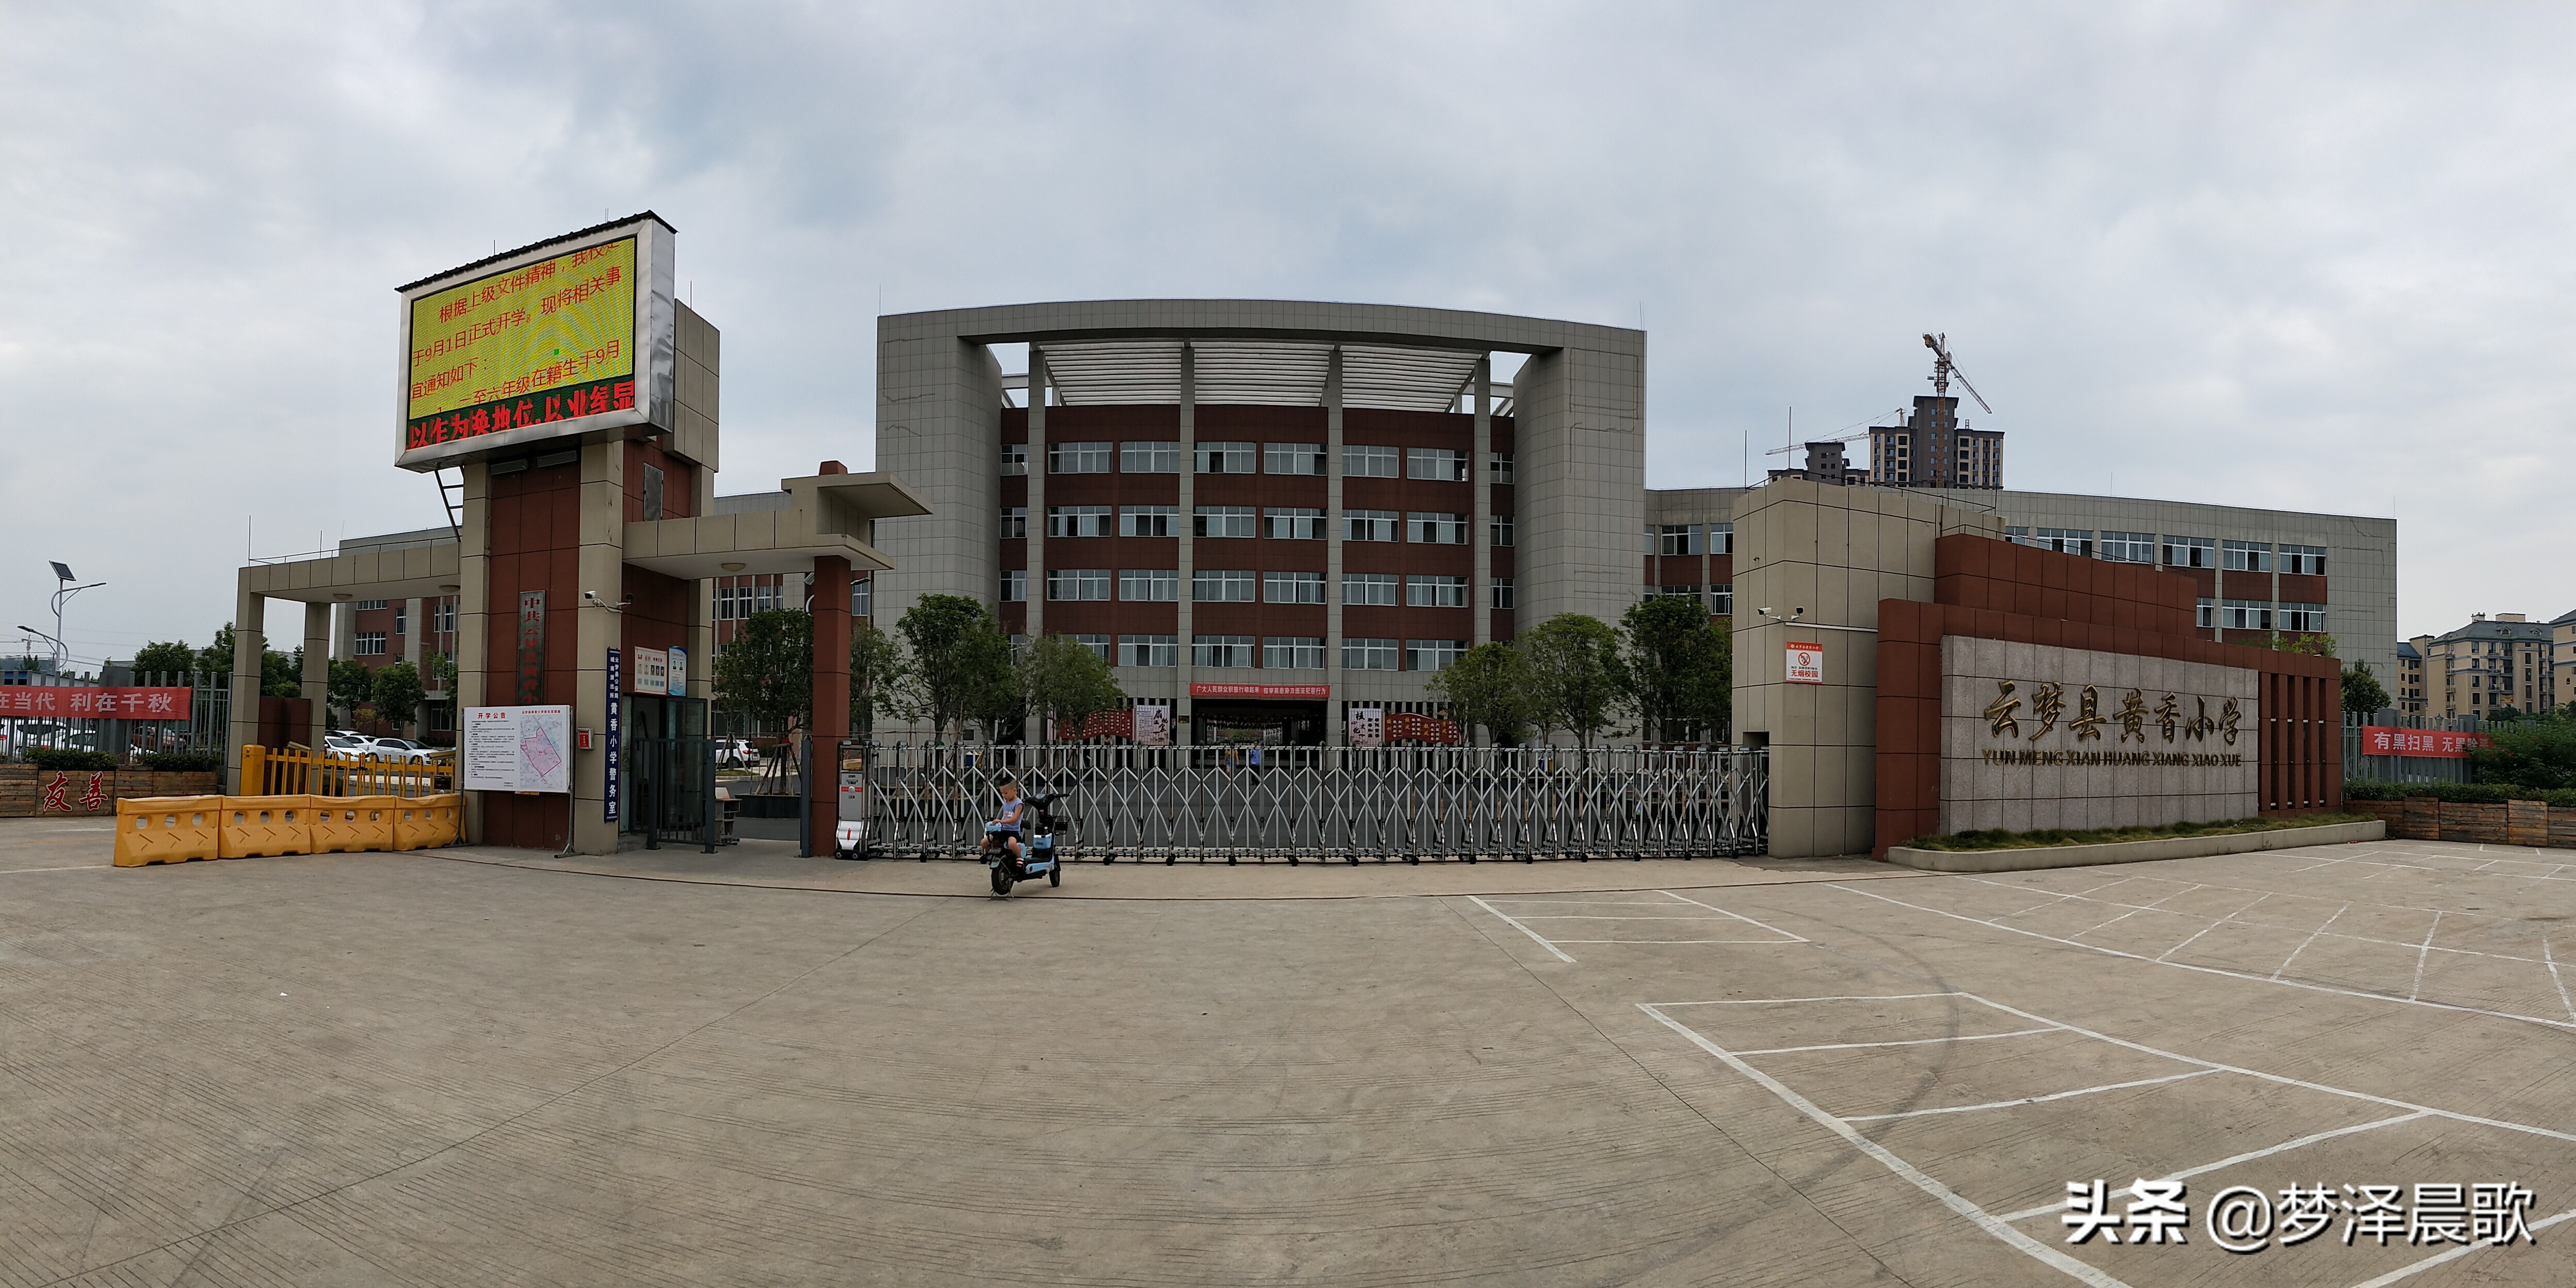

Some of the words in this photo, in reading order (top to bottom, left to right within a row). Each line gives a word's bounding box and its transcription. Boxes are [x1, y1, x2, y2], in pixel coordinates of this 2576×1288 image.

[1791, 669, 1818, 678] 无烟校园
[70, 692, 173, 713] 利在千秋
[1984, 679, 2242, 746] 云梦县黄香小学
[2373, 731, 2435, 752] 有黑扫黑
[608, 702, 618, 814] 黄香小学警务室
[1982, 748, 2016, 765] YUN
[2019, 749, 2064, 766] MENG
[2066, 750, 2101, 766] XIAN
[2103, 751, 2150, 766] HUANG
[2152, 751, 2189, 766] XIANG
[2192, 752, 2219, 767] XIAO
[2220, 752, 2242, 767] XUE
[43, 770, 108, 813] 友善
